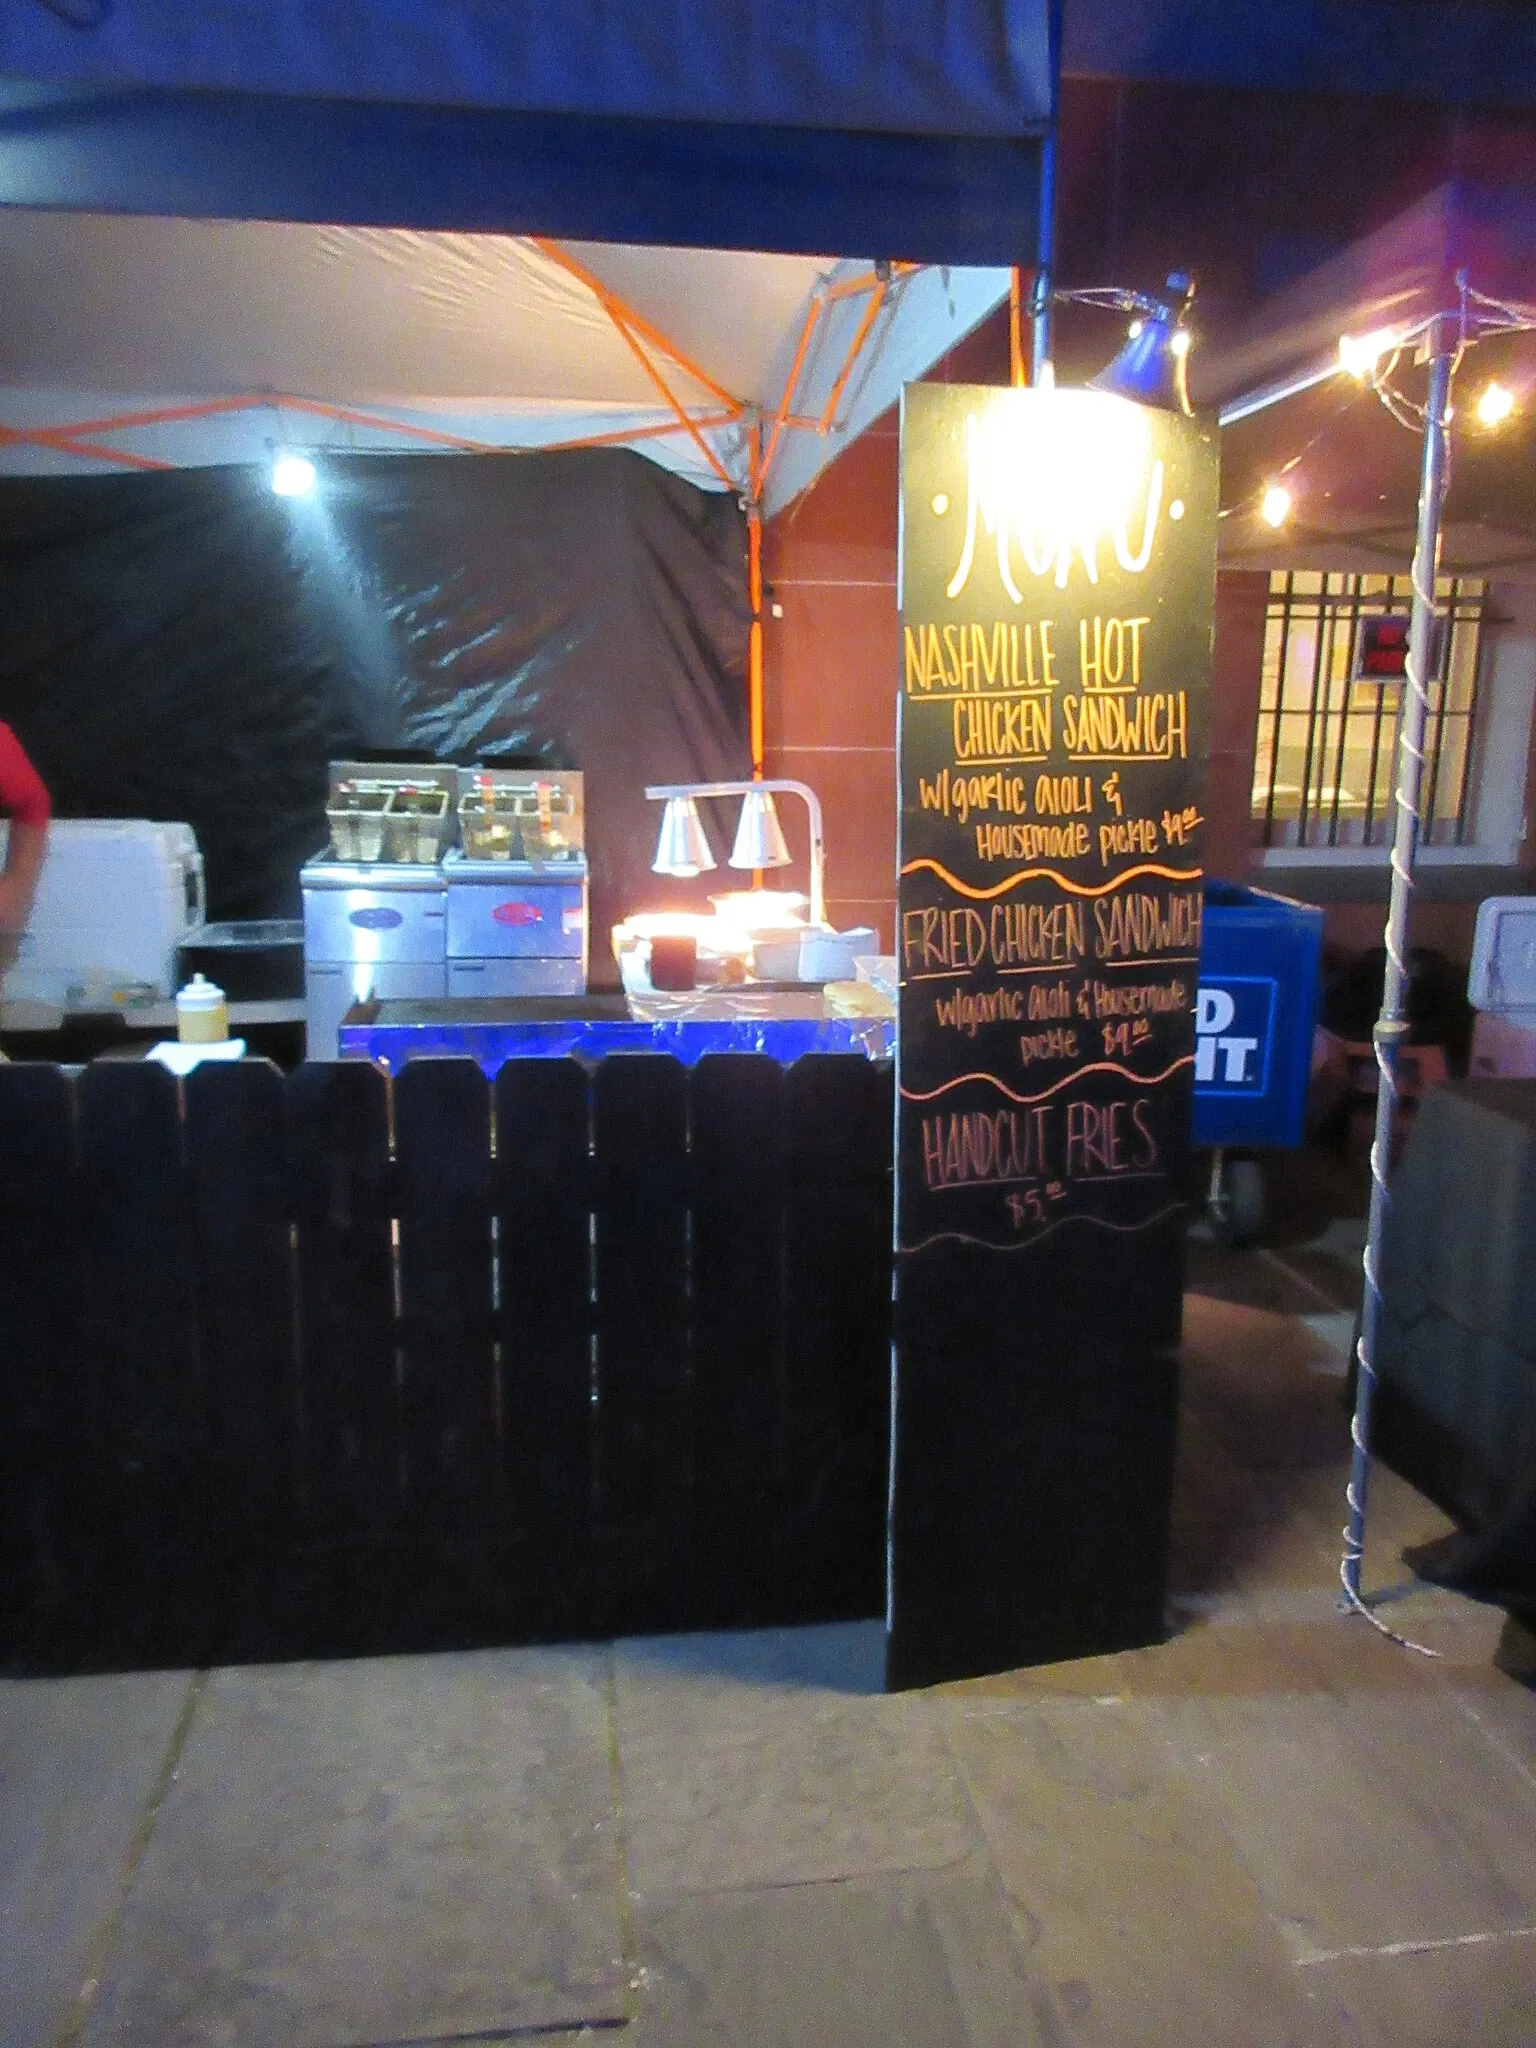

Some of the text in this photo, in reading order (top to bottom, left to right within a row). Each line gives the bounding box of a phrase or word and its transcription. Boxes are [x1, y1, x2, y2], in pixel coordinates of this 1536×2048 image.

[945, 411, 1164, 604] MU
[904, 616, 1151, 693] NASHVILLE HOT
[953, 690, 1187, 759] CHICKEN SANDWICH
[1101, 771, 1123, 816] &
[903, 892, 1204, 969] FRIED CHICKEN SANDWICH
[1066, 1099, 1158, 1176] FRIES
